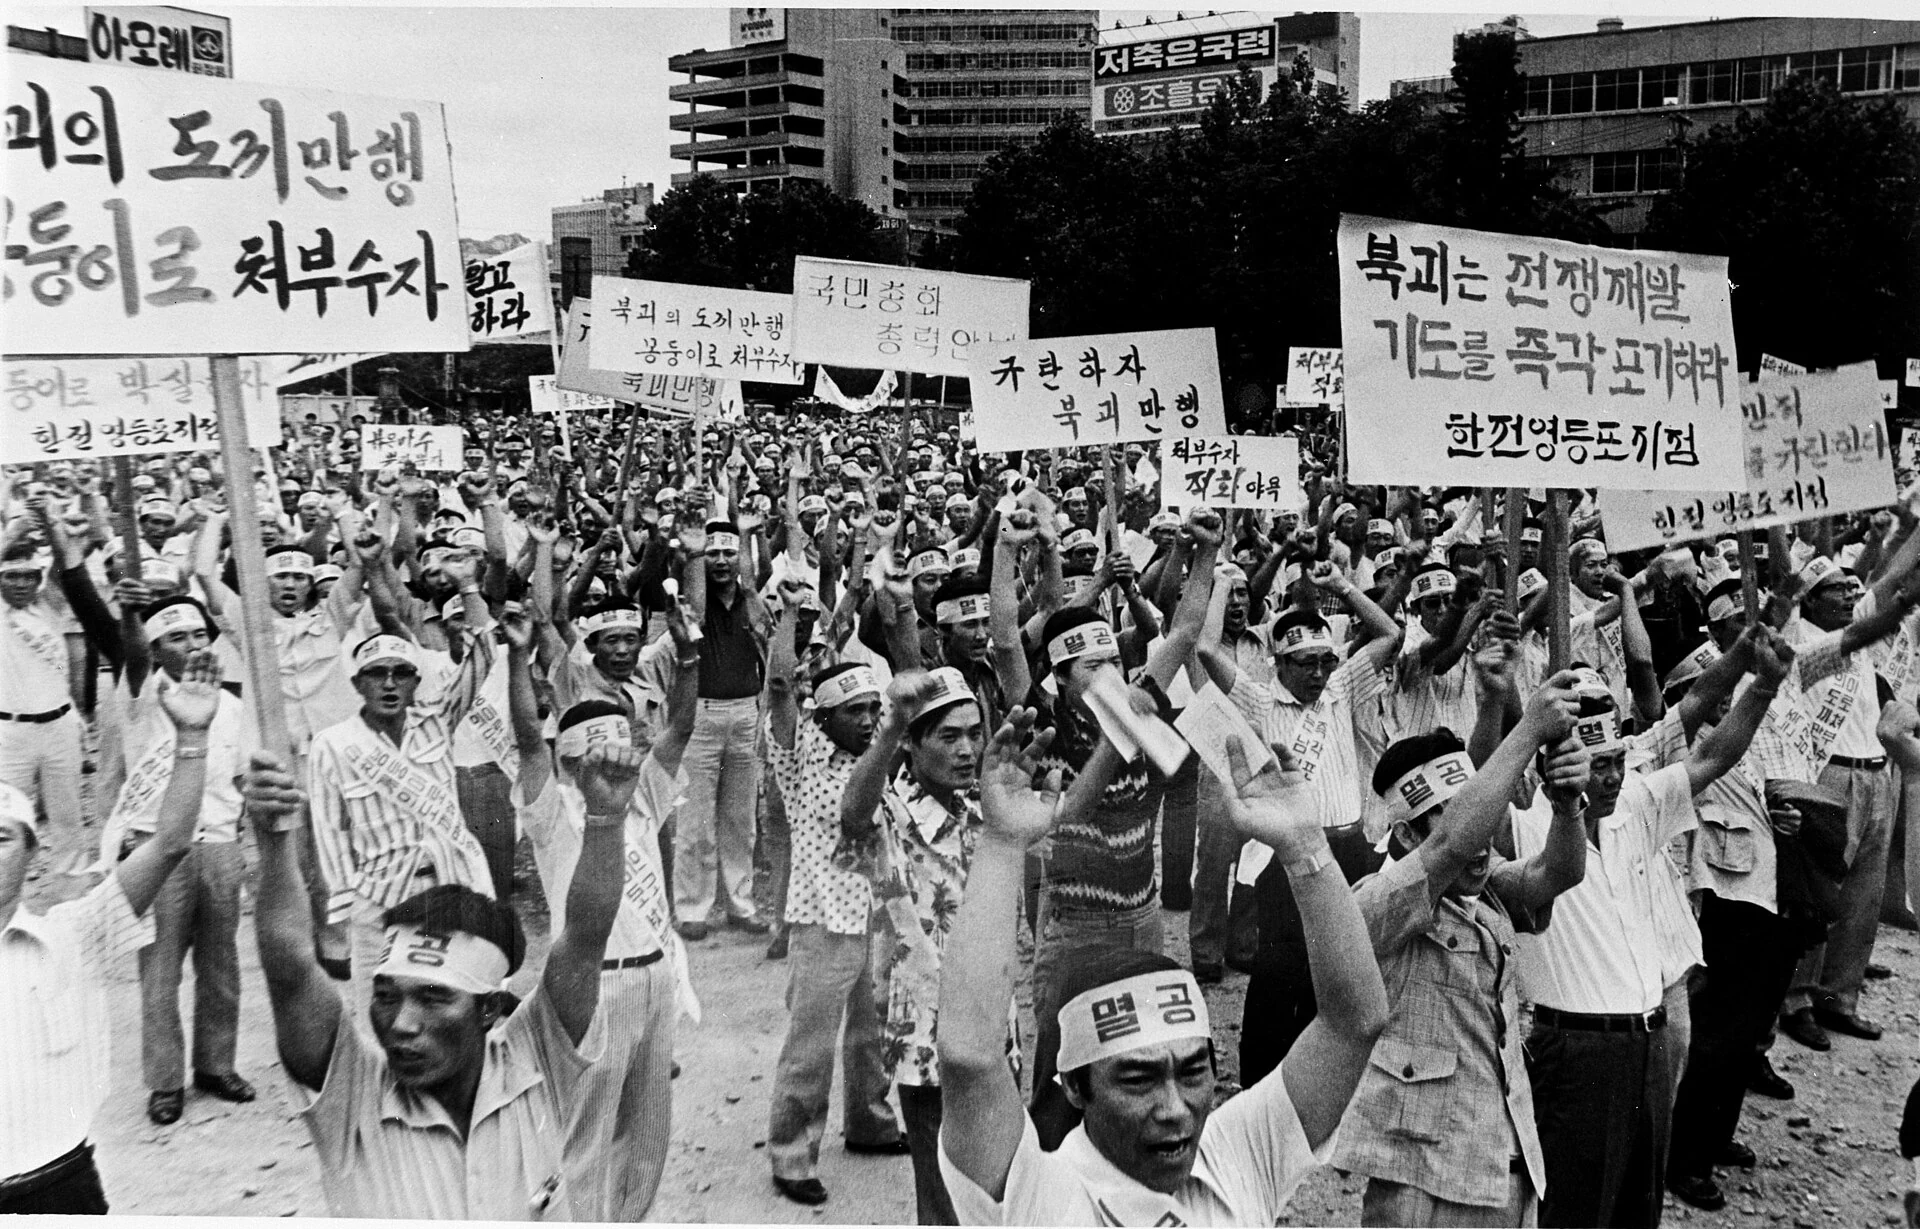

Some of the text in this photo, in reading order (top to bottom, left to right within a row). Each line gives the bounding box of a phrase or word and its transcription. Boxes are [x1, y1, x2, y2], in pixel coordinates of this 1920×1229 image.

[91, 12, 190, 73] 아모레
[1098, 29, 1270, 75] 저축은국력
[1139, 77, 1222, 112] 조흥은
[1357, 232, 1489, 305] 북괴는
[470, 291, 531, 336] 하라
[634, 337, 723, 368] 몽둥이로
[990, 343, 1147, 392] 규탄하자
[1373, 312, 1729, 409] 기도를 즉각 포기하라
[116, 359, 269, 405] 박살자
[1246, 471, 1282, 502] 야욕
[1063, 626, 1113, 656] 멸공
[1400, 759, 1468, 810] 멸공
[1091, 982, 1197, 1044] 멸공
